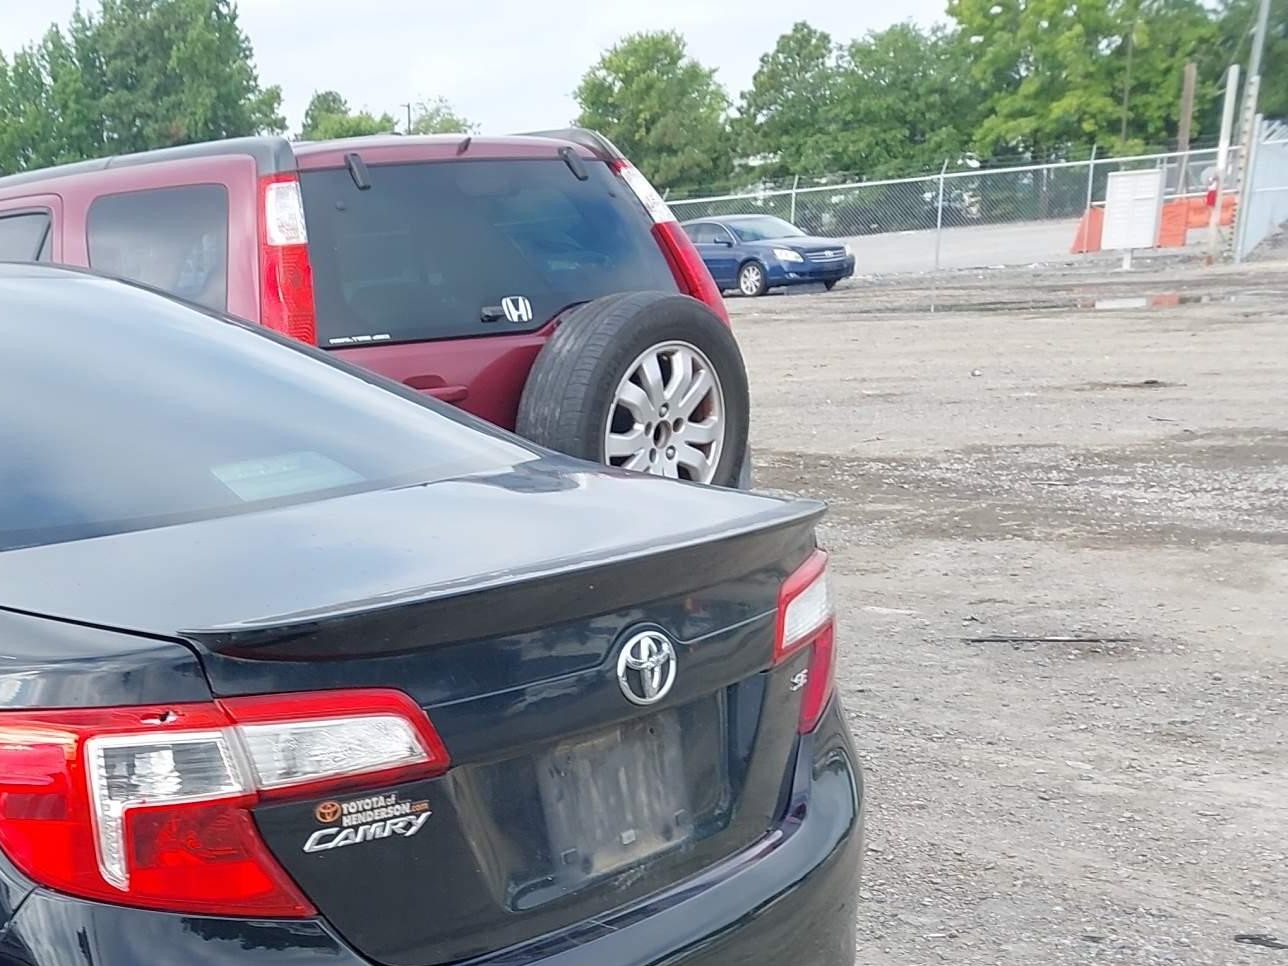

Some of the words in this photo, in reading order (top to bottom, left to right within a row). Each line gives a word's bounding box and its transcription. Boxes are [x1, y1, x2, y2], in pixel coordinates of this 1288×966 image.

[790, 668, 808, 691] SE
[342, 796, 385, 814] TOYOTA
[385, 794, 397, 806] of
[302, 811, 432, 853] CAMRY
